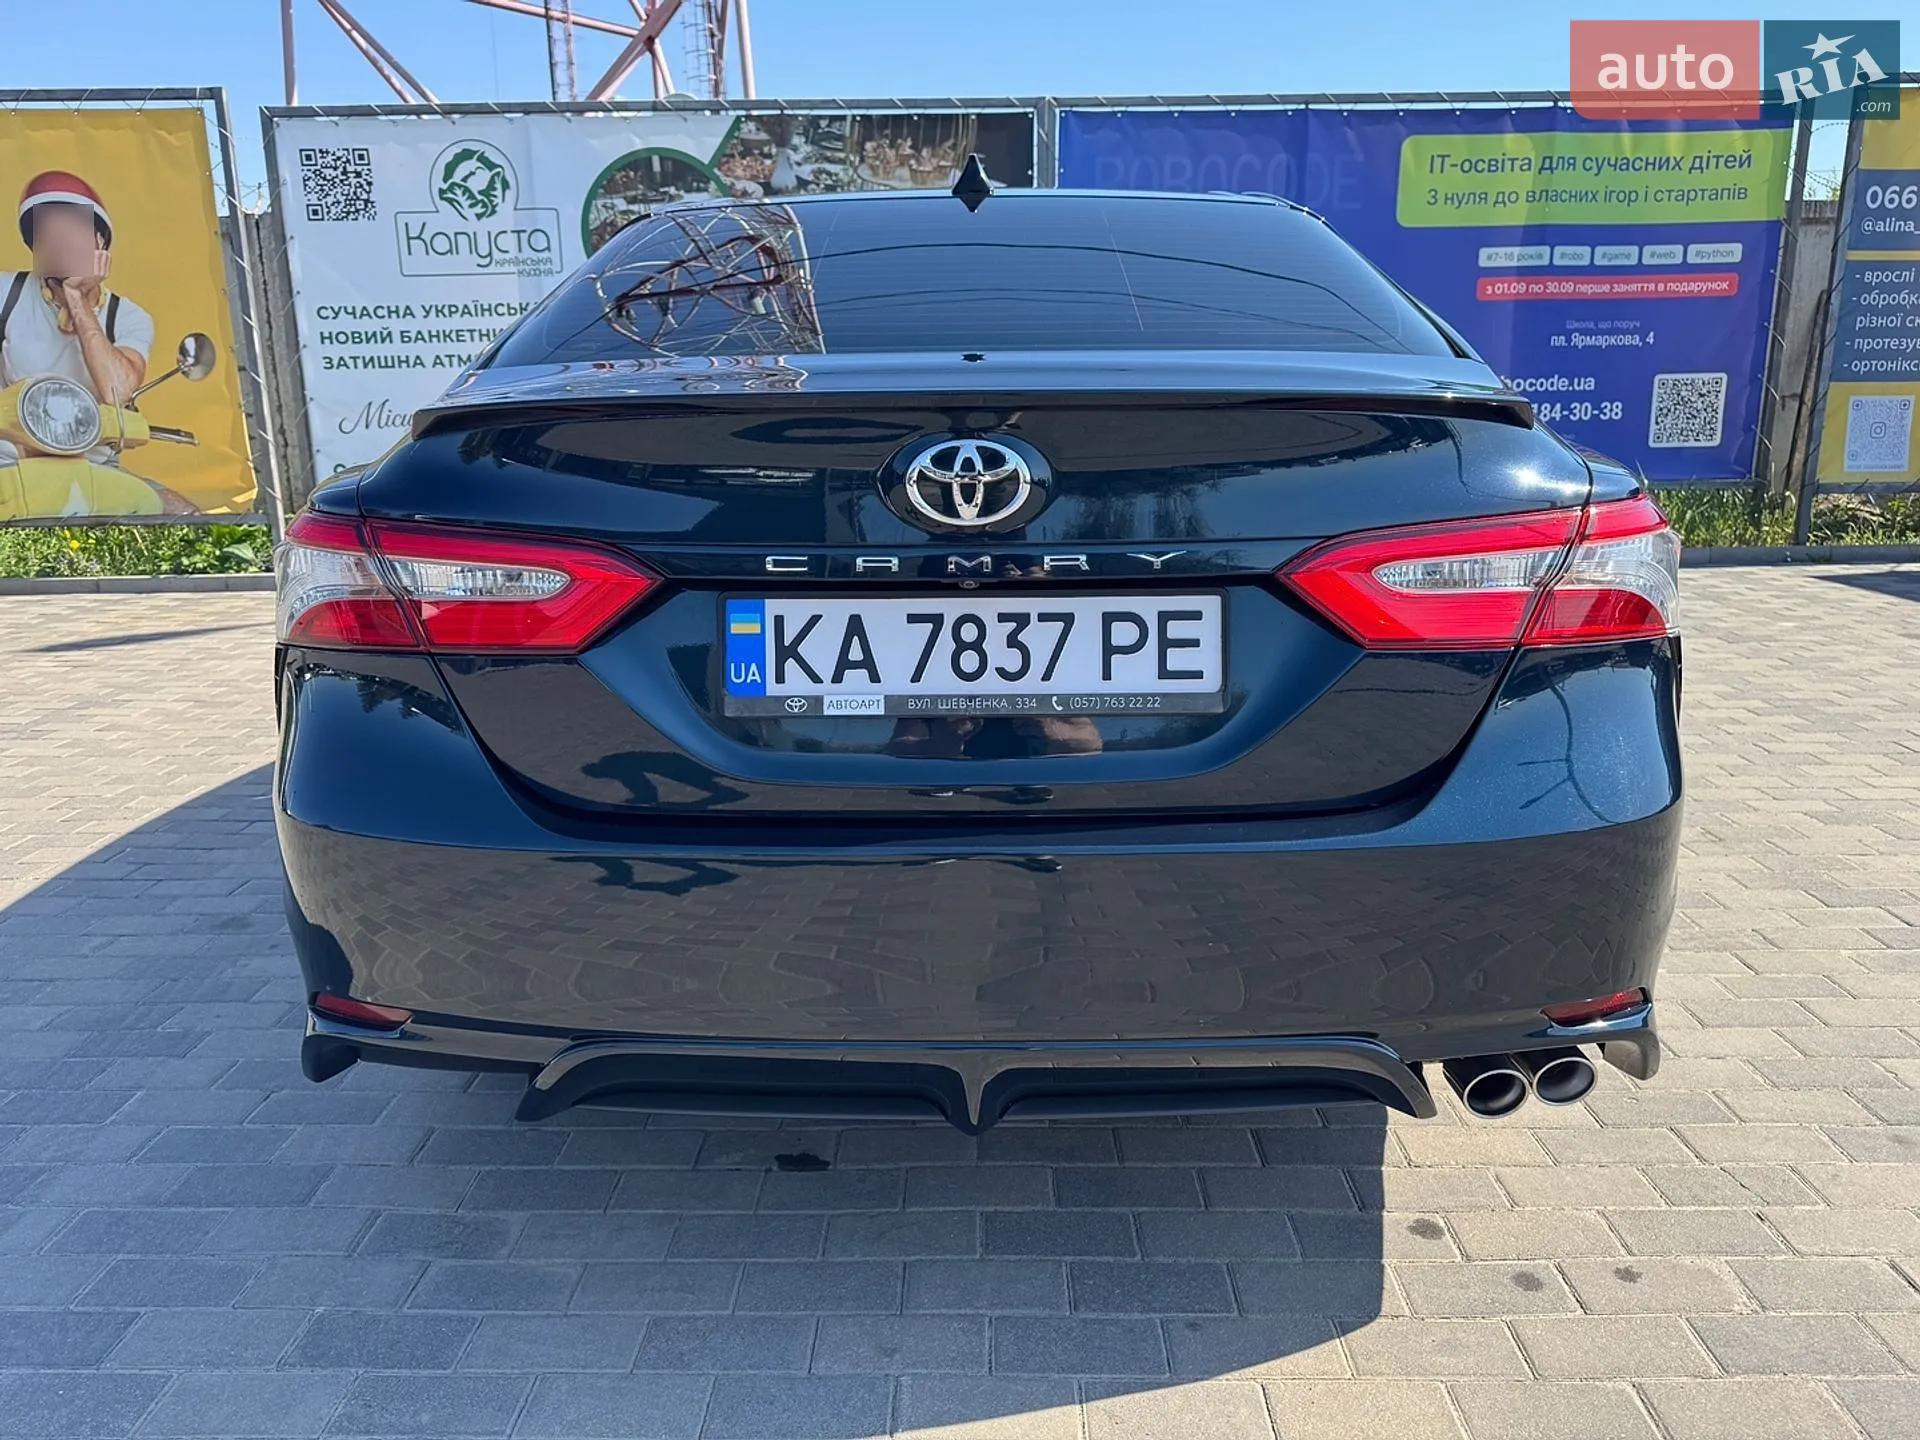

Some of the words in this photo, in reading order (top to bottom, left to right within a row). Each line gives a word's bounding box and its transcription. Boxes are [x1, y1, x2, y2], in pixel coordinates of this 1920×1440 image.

[1538, 155, 1576, 175] для
[1582, 155, 1684, 176] сучасних
[1688, 149, 1753, 174] дітей
[1444, 191, 1488, 209] нуля
[1493, 190, 1519, 207] до
[1526, 188, 1599, 204] власних
[1604, 186, 1639, 207] ігор
[1644, 186, 1649, 202] і
[1653, 183, 1749, 206] стартапів
[1865, 185, 1918, 209] 066
[404, 222, 552, 268] Капуста
[1649, 249, 1676, 259] #web
[1695, 248, 1735, 260] #python
[1864, 267, 1915, 286] врослі
[1494, 282, 1527, 294] 01.09
[1528, 283, 1544, 293] по
[1545, 281, 1574, 293] 30.09
[1576, 283, 1610, 295] перше
[1612, 282, 1655, 293] заняття
[1667, 280, 1730, 293] подарунок
[1860, 289, 1920, 309] обробк
[316, 304, 416, 320] СУЧАСНА
[421, 300, 537, 319] УКРАЇНСЬК
[1855, 312, 1904, 331] різної
[319, 326, 394, 345] НОВИЙ
[1550, 335, 1568, 346] пл.
[1570, 332, 1643, 349] Ярмаркова,
[1646, 331, 1655, 345] 4
[322, 354, 426, 370] ЗАТИШНА
[432, 353, 478, 369] АТМ
[1851, 357, 1920, 375] ортонікс
[765, 550, 1187, 572] CAMRY
[774, 613, 882, 685] KA
[906, 611, 1075, 684] 7837
[1101, 610, 1204, 681] PE
[730, 662, 761, 684] UA
[826, 699, 882, 711] АВТОАРТ
[937, 698, 1012, 710] ШЕВЧЕНКА,
[1015, 697, 1037, 708] 334
[1069, 696, 1100, 710] (057)
[1104, 697, 1126, 708] 763
[1129, 696, 1143, 708] 22
[1146, 696, 1161, 708] 22
